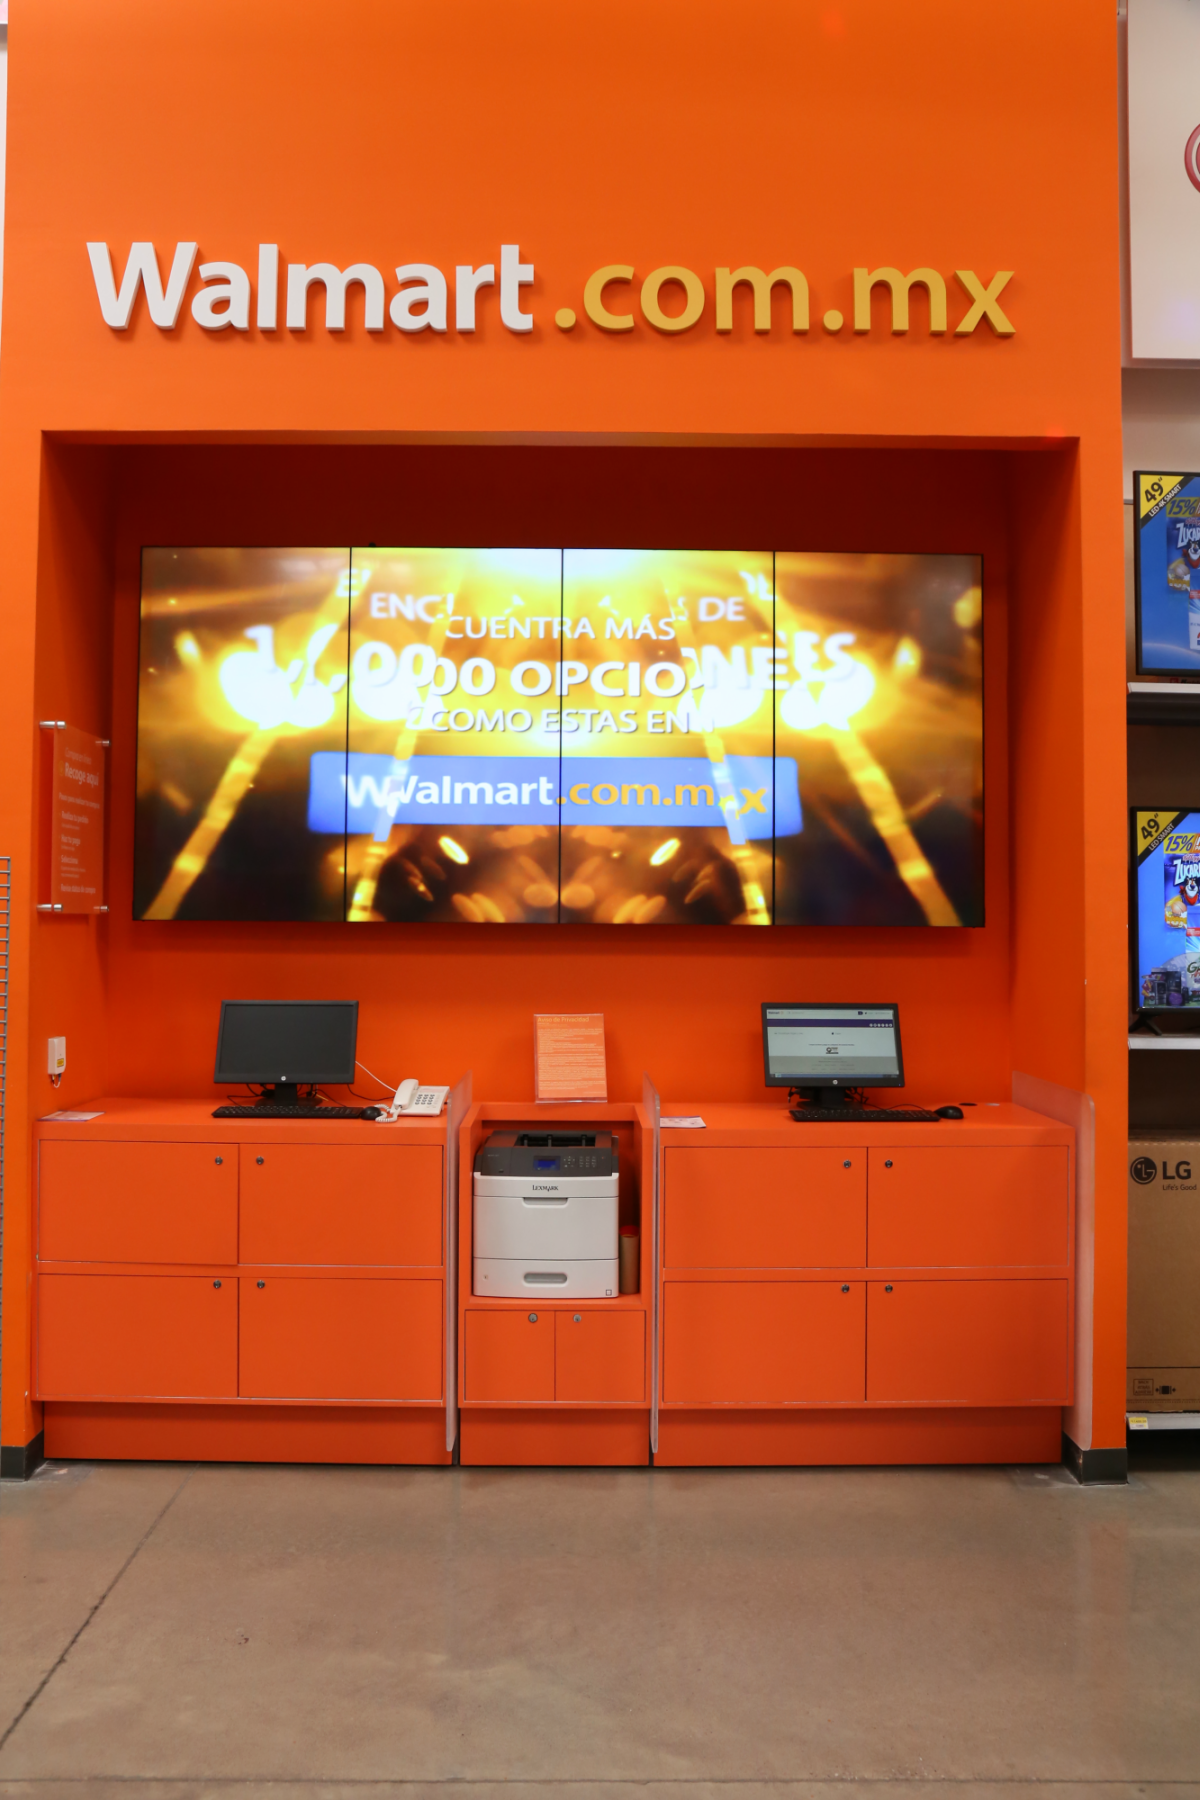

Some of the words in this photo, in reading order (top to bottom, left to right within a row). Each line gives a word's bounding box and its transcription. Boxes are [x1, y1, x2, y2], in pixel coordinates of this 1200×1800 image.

[1148, 504, 1160, 517] LED
[1163, 483, 1182, 503] SMART
[1167, 498, 1197, 515] 15%
[698, 596, 747, 622] DE
[433, 708, 533, 733] COMO
[541, 708, 638, 734] ESTAS
[647, 710, 690, 734] EN
[1148, 839, 1160, 851] LED
[1157, 822, 1175, 842] SMART
[1165, 835, 1194, 852] 15%
[1162, 1160, 1192, 1180] LG
[532, 1184, 559, 1192] LEXMARK
